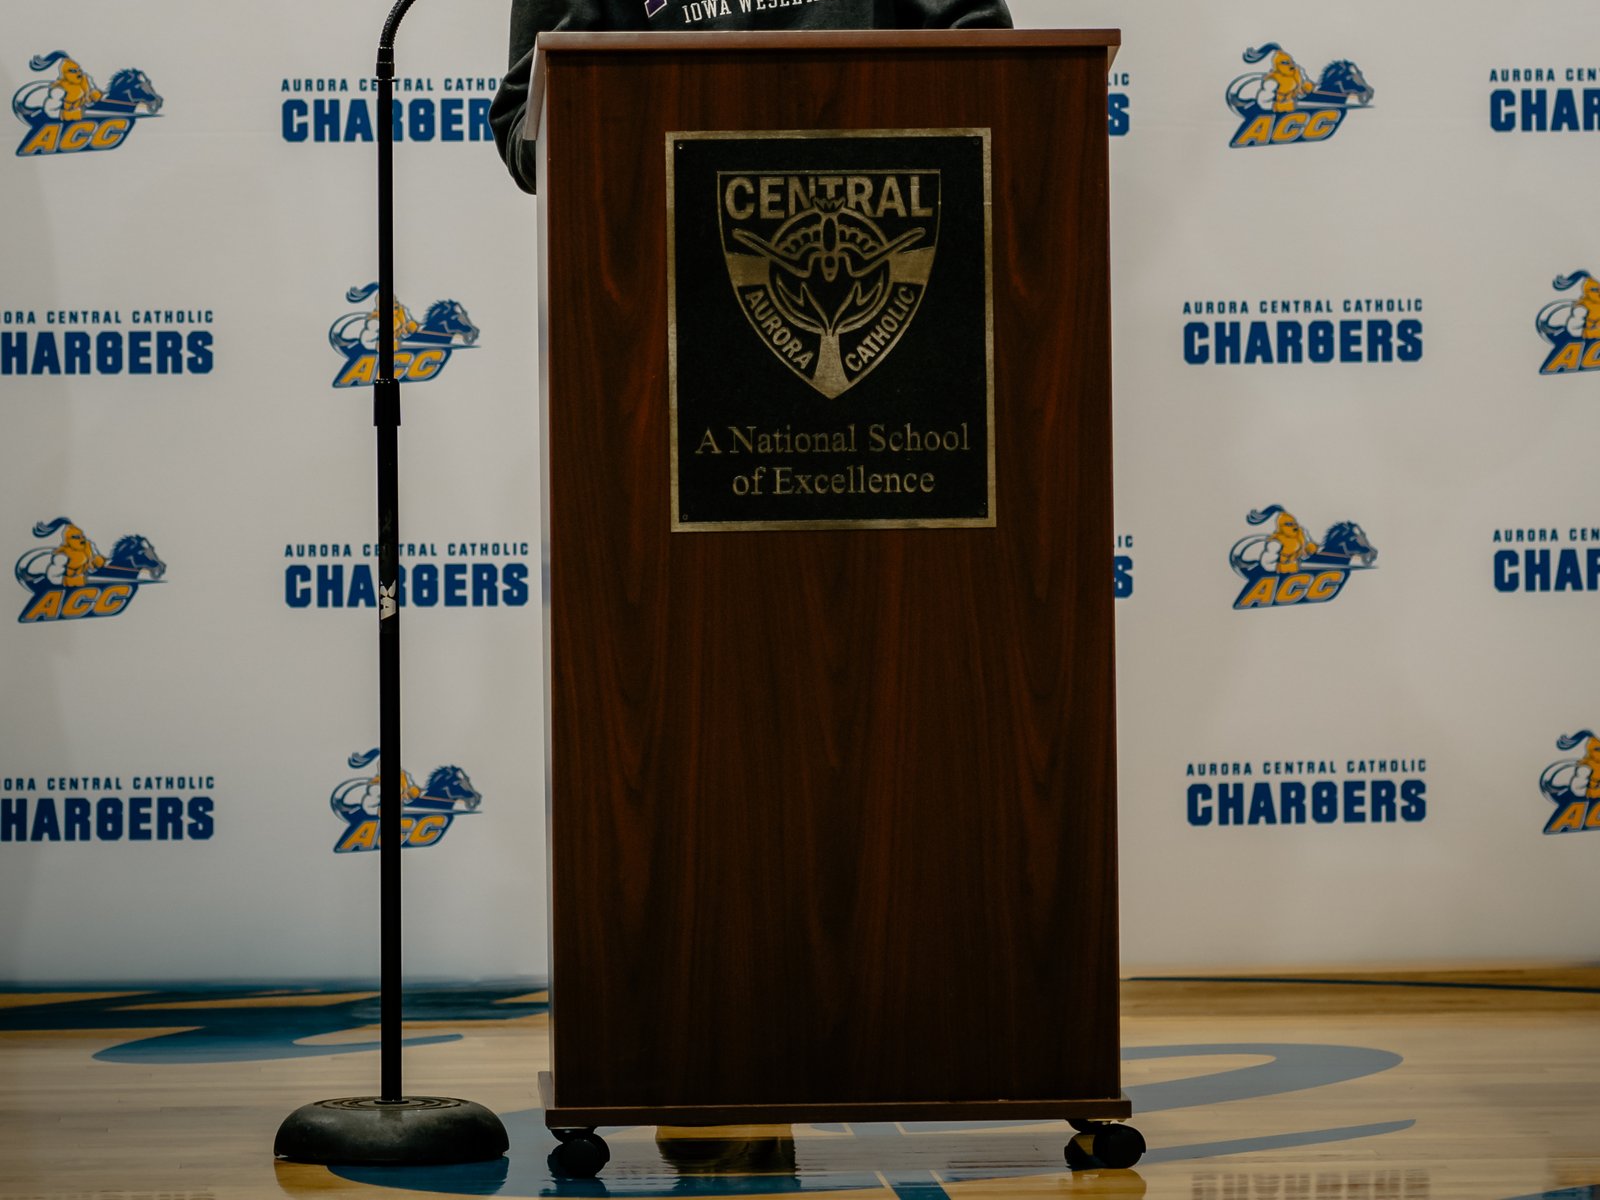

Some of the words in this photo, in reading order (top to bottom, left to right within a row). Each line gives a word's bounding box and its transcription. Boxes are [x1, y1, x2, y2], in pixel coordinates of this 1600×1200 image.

[682, 0, 732, 23] IOWA
[281, 78, 348, 92] AURORA
[359, 77, 433, 92] CETRAL
[1489, 68, 1555, 82] AURORA
[1565, 68, 1600, 82] CEN
[24, 118, 128, 154] ACC
[1237, 109, 1339, 145] ACC
[725, 176, 933, 220] CENTRAL
[46, 310, 121, 324] CENTRAL
[132, 310, 213, 324] CATHOLIC
[1183, 300, 1249, 315] AURORA
[1259, 299, 1333, 314] CENTRAL
[1343, 298, 1423, 313] CATHOLIC
[745, 288, 814, 370] AURORA
[845, 285, 915, 373] CATHOLIC
[1183, 319, 1423, 365] CHARGERS
[0, 330, 214, 376] HARGERS
[695, 427, 722, 454] A
[728, 424, 856, 453] National
[869, 423, 970, 452] School
[732, 467, 767, 495] of
[773, 467, 935, 494] Excellence
[284, 543, 352, 558] AURORA
[362, 542, 437, 557] CETRAL
[447, 542, 528, 556] CATHOLIC
[1493, 528, 1559, 543] AURORA
[285, 562, 529, 608] CHAGERS
[1240, 570, 1343, 606] ACC
[26, 584, 131, 620] ACC
[47, 777, 122, 791] CENTRAL
[132, 776, 214, 790] CATHOLIC
[1186, 762, 1252, 776] AURORA
[1263, 760, 1336, 775] CENTRAL
[1346, 759, 1426, 774] CATHOLIC
[0, 796, 214, 843] HARGERS
[1186, 779, 1427, 827] CHARGERS
